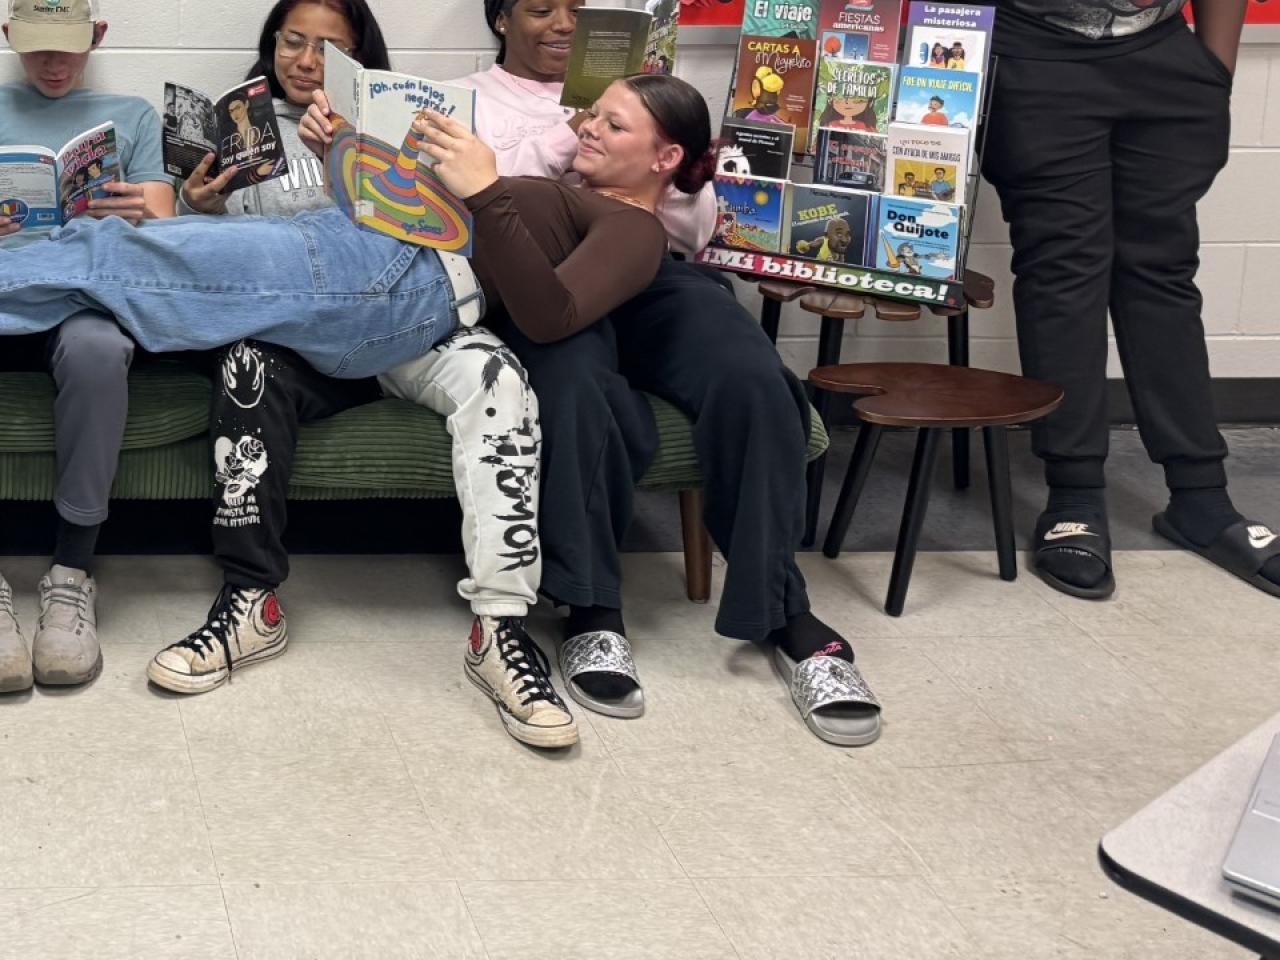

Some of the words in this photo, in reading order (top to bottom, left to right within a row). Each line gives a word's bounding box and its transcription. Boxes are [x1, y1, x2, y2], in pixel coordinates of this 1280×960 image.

[754, 0, 769, 18] El
[774, 2, 813, 22] viaje
[924, 5, 936, 13] La
[938, 7, 982, 17] pasajera
[838, 12, 881, 25] FIESTAS
[923, 17, 977, 28] misteriosa
[832, 22, 885, 33] americanas
[748, 41, 790, 54] CARTAS
[792, 45, 800, 54] A
[392, 80, 416, 90] cuán
[419, 80, 445, 102] lejos
[827, 82, 837, 95] DE
[843, 83, 877, 98] FAMILIA
[222, 121, 275, 158] FRIDA
[261, 140, 277, 154] soy
[798, 203, 838, 221] KOBE
[887, 210, 916, 223] Don
[894, 222, 949, 240] Quijote
[702, 247, 754, 270] ¡Mi
[761, 256, 949, 301] biblioteca!
[1052, 522, 1089, 533] NIKE
